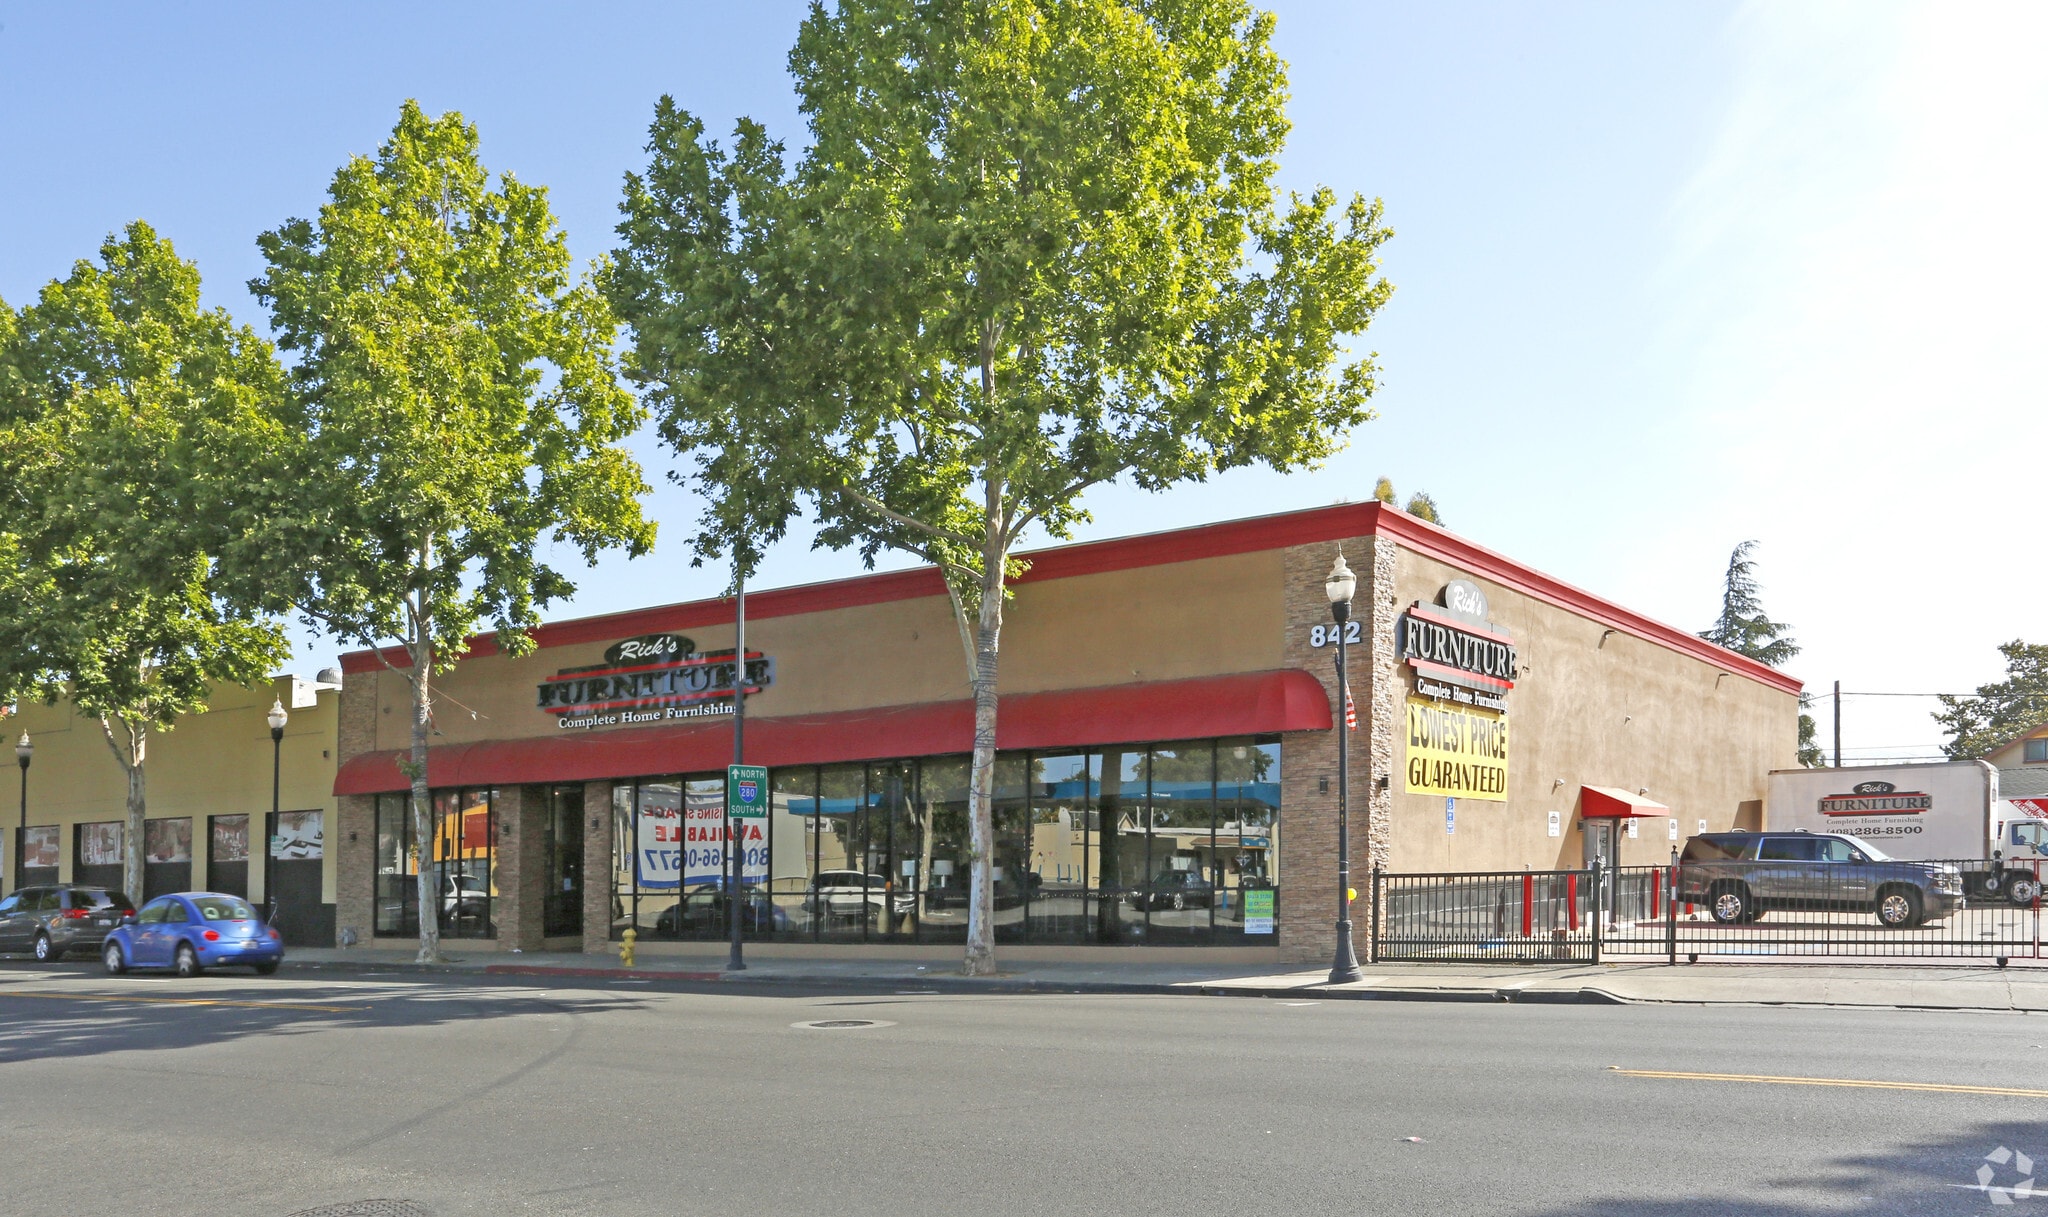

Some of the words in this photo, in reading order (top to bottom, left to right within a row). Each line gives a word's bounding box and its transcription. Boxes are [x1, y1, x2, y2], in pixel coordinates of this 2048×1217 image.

[1452, 585, 1482, 616] Rick's
[619, 636, 678, 660] Rick's
[1310, 621, 1361, 648] 842
[1405, 617, 1518, 679] FURNITURE
[537, 659, 770, 707] FURNITURE
[1417, 679, 1451, 702] Complete
[1453, 686, 1473, 704] Home
[1474, 691, 1509, 713] Furnishing
[558, 715, 616, 729] Complete
[621, 711, 661, 723] Home
[666, 702, 736, 720] Furnishin
[1410, 705, 1466, 753] LOWEST
[1470, 716, 1506, 760] PRICE
[740, 769, 765, 779] NORTH
[1409, 757, 1505, 794] GUARANTEED
[741, 788, 755, 798] 280
[1861, 783, 1888, 793] Rick's
[731, 804, 755, 814] SOUTH
[1820, 796, 1932, 812] FURNITURE
[1826, 818, 1858, 826] Complete
